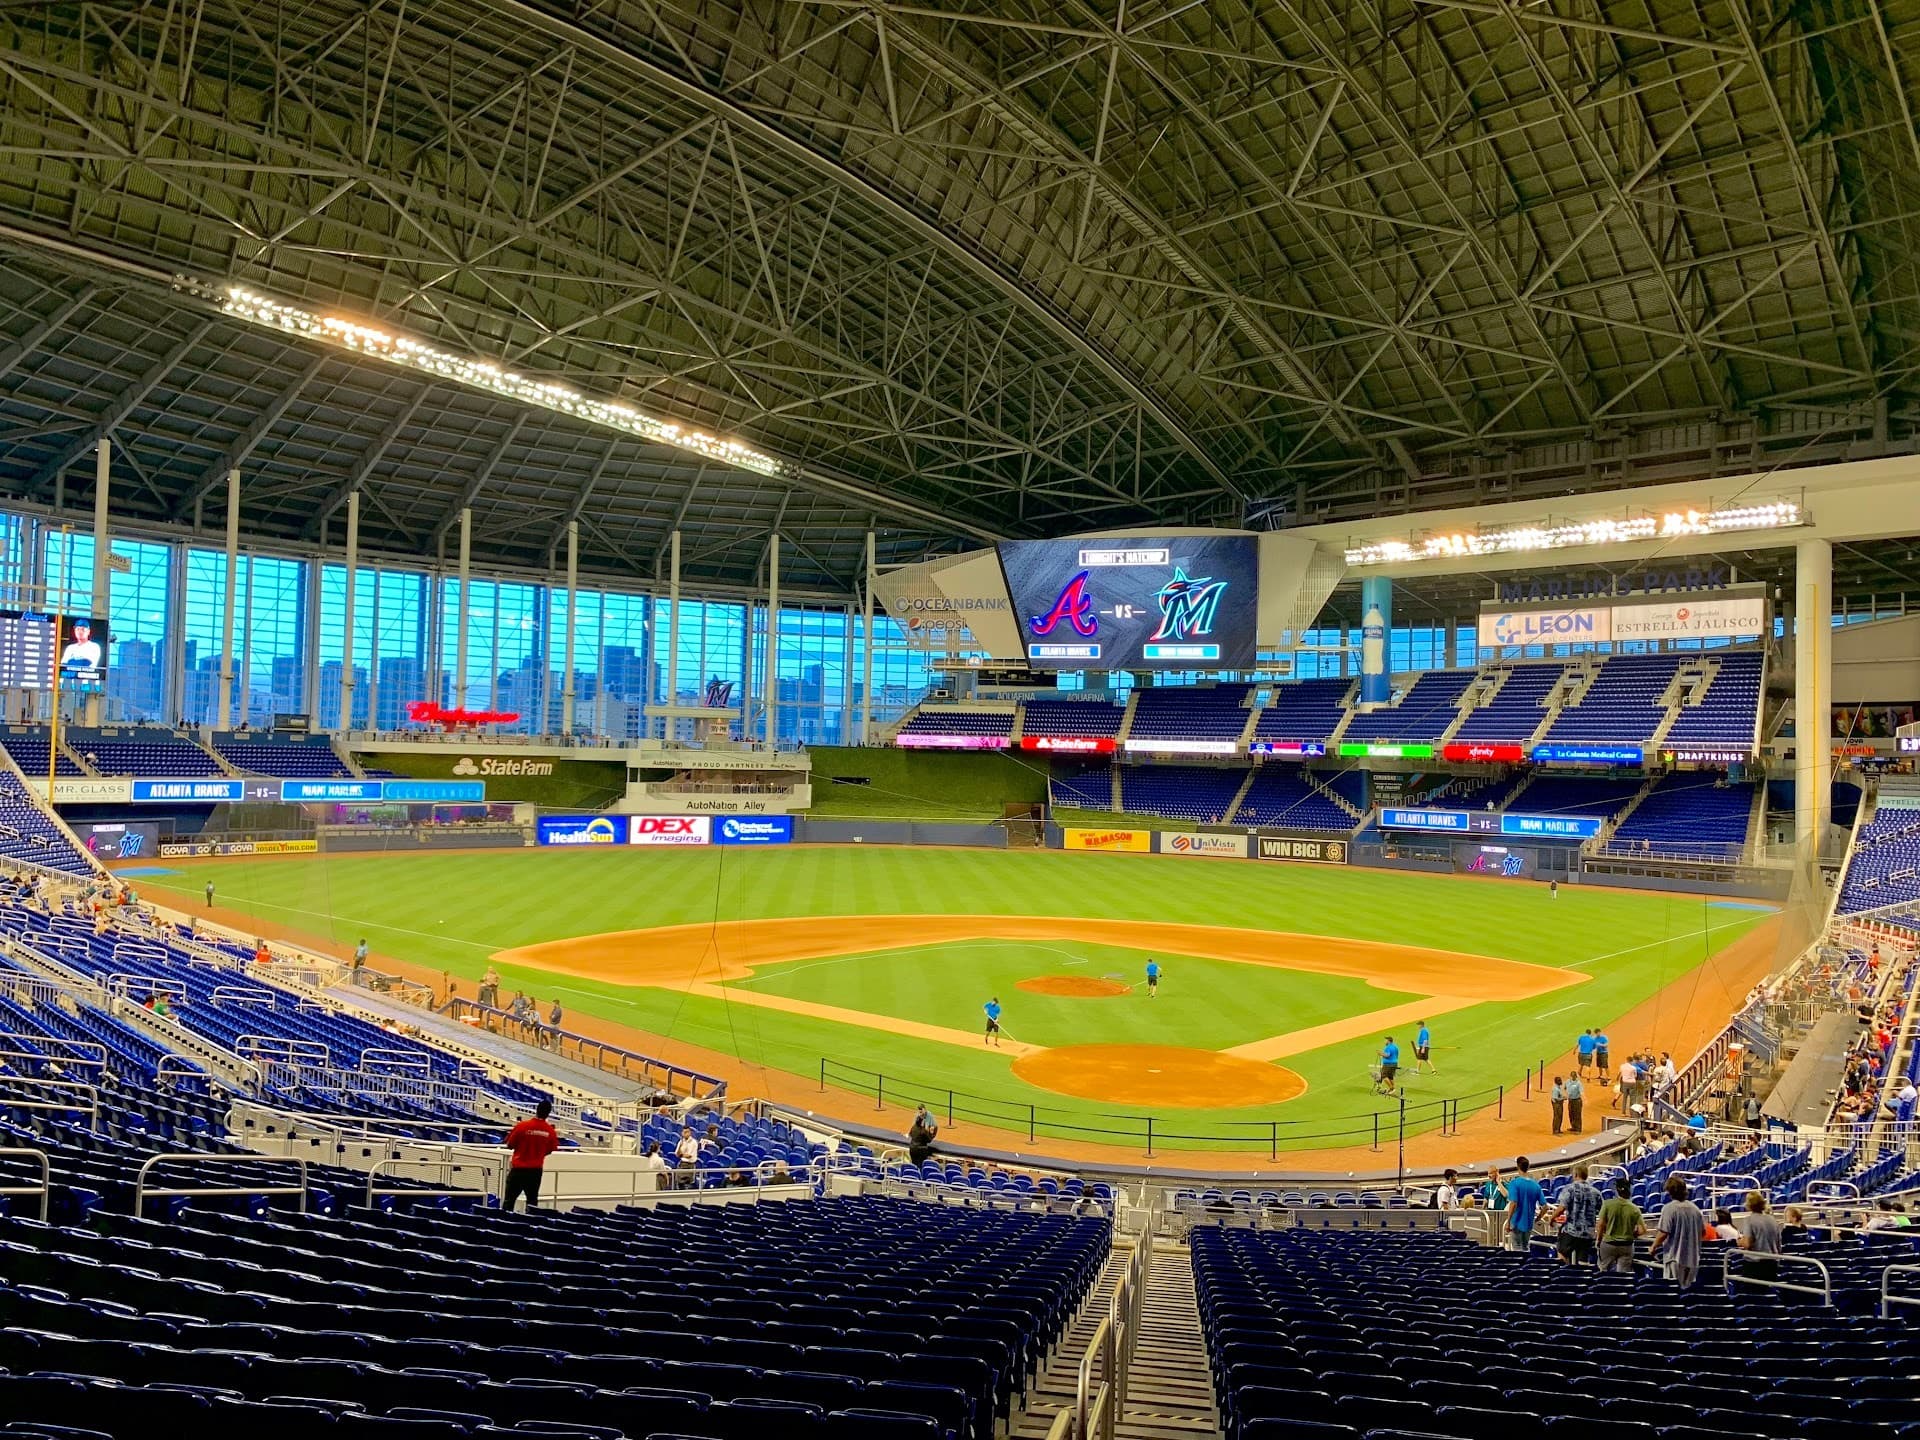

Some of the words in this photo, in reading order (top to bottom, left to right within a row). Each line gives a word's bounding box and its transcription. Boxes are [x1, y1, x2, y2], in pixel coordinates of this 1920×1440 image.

[1501, 578, 1632, 603] MARLINS
[1643, 567, 1727, 595] PARK
[913, 598, 1007, 611] OCEANBANK
[1115, 604, 1132, 618] VS
[925, 618, 967, 632] pepsi
[1525, 613, 1593, 635] LEON
[1616, 621, 1688, 634] ESTRELLA
[1694, 617, 1759, 630] JALISCO
[1469, 747, 1495, 757] xfinity
[1677, 752, 1744, 761] DRAFTKINGS
[54, 785, 78, 794] MR.
[80, 785, 125, 794] GLASS
[150, 785, 191, 798] ATLANTA
[256, 787, 269, 798] VS
[686, 800, 738, 812] AutoNation
[743, 801, 766, 812] Alley
[638, 818, 697, 833] DEX
[1394, 812, 1427, 825] ATLANTA
[1480, 820, 1491, 829] VS
[651, 834, 703, 843] imaging
[163, 846, 189, 855] GOYA
[230, 844, 253, 853] GOYA
[1263, 841, 1291, 856] WIN
[1292, 843, 1321, 858] BIG!
